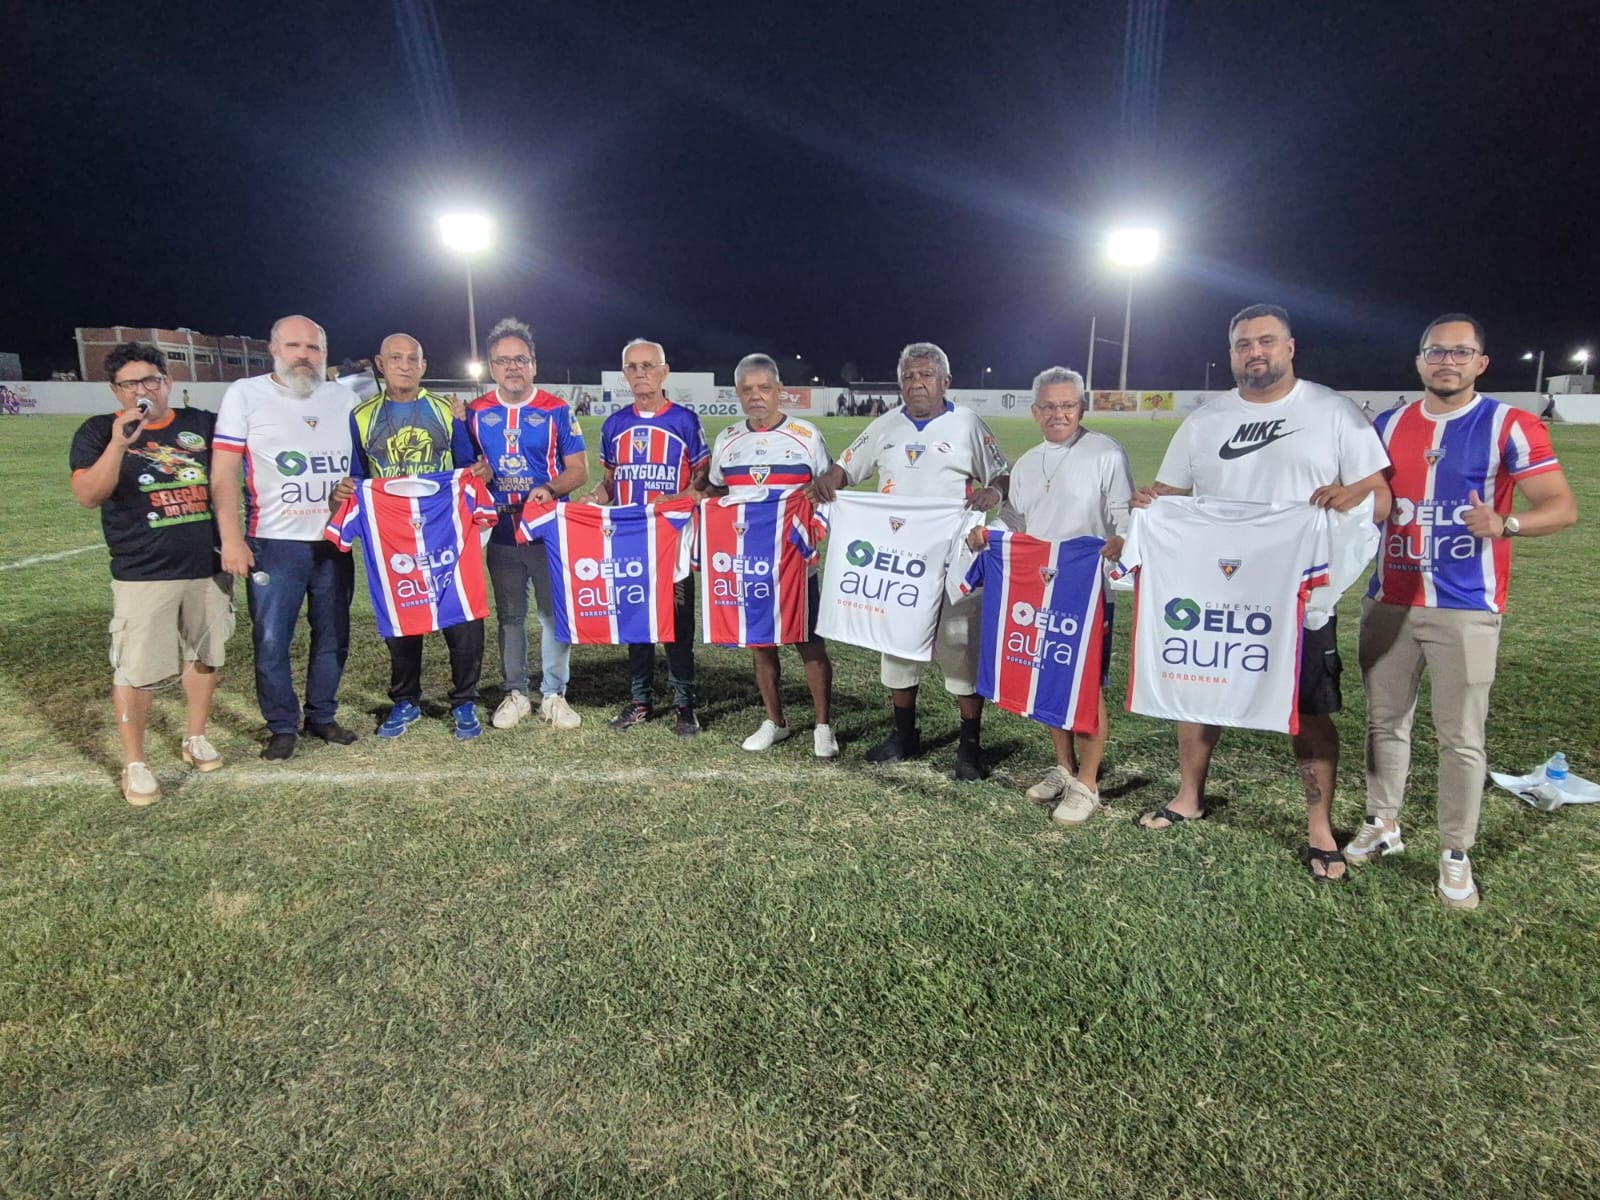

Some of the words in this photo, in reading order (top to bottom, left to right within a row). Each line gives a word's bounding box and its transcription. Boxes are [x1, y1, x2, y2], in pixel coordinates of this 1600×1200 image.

[699, 403, 738, 415] 2026
[1231, 418, 1286, 443] NIKE
[310, 455, 349, 474] ELO
[281, 480, 340, 504] aur
[644, 480, 675, 490] MASTER
[150, 485, 208, 507] SELEÇÃO
[164, 504, 181, 517] DO
[878, 546, 928, 561] CIMENTO
[1388, 534, 1476, 560] aura
[415, 550, 455, 571] ELO
[600, 561, 644, 579] ELO
[732, 558, 770, 576] ELO
[874, 552, 926, 578] ELO
[397, 571, 453, 598] aura
[713, 578, 770, 599] aura
[839, 571, 919, 608] aura
[578, 584, 645, 607] aura
[837, 598, 885, 615] BORBOREMA
[1205, 601, 1272, 613] CIMENTO
[1034, 612, 1078, 636] ELO
[1203, 609, 1272, 636] ELO
[1008, 631, 1072, 665] aura
[1162, 637, 1269, 672] aura
[1161, 671, 1228, 684] BORBOREMA
